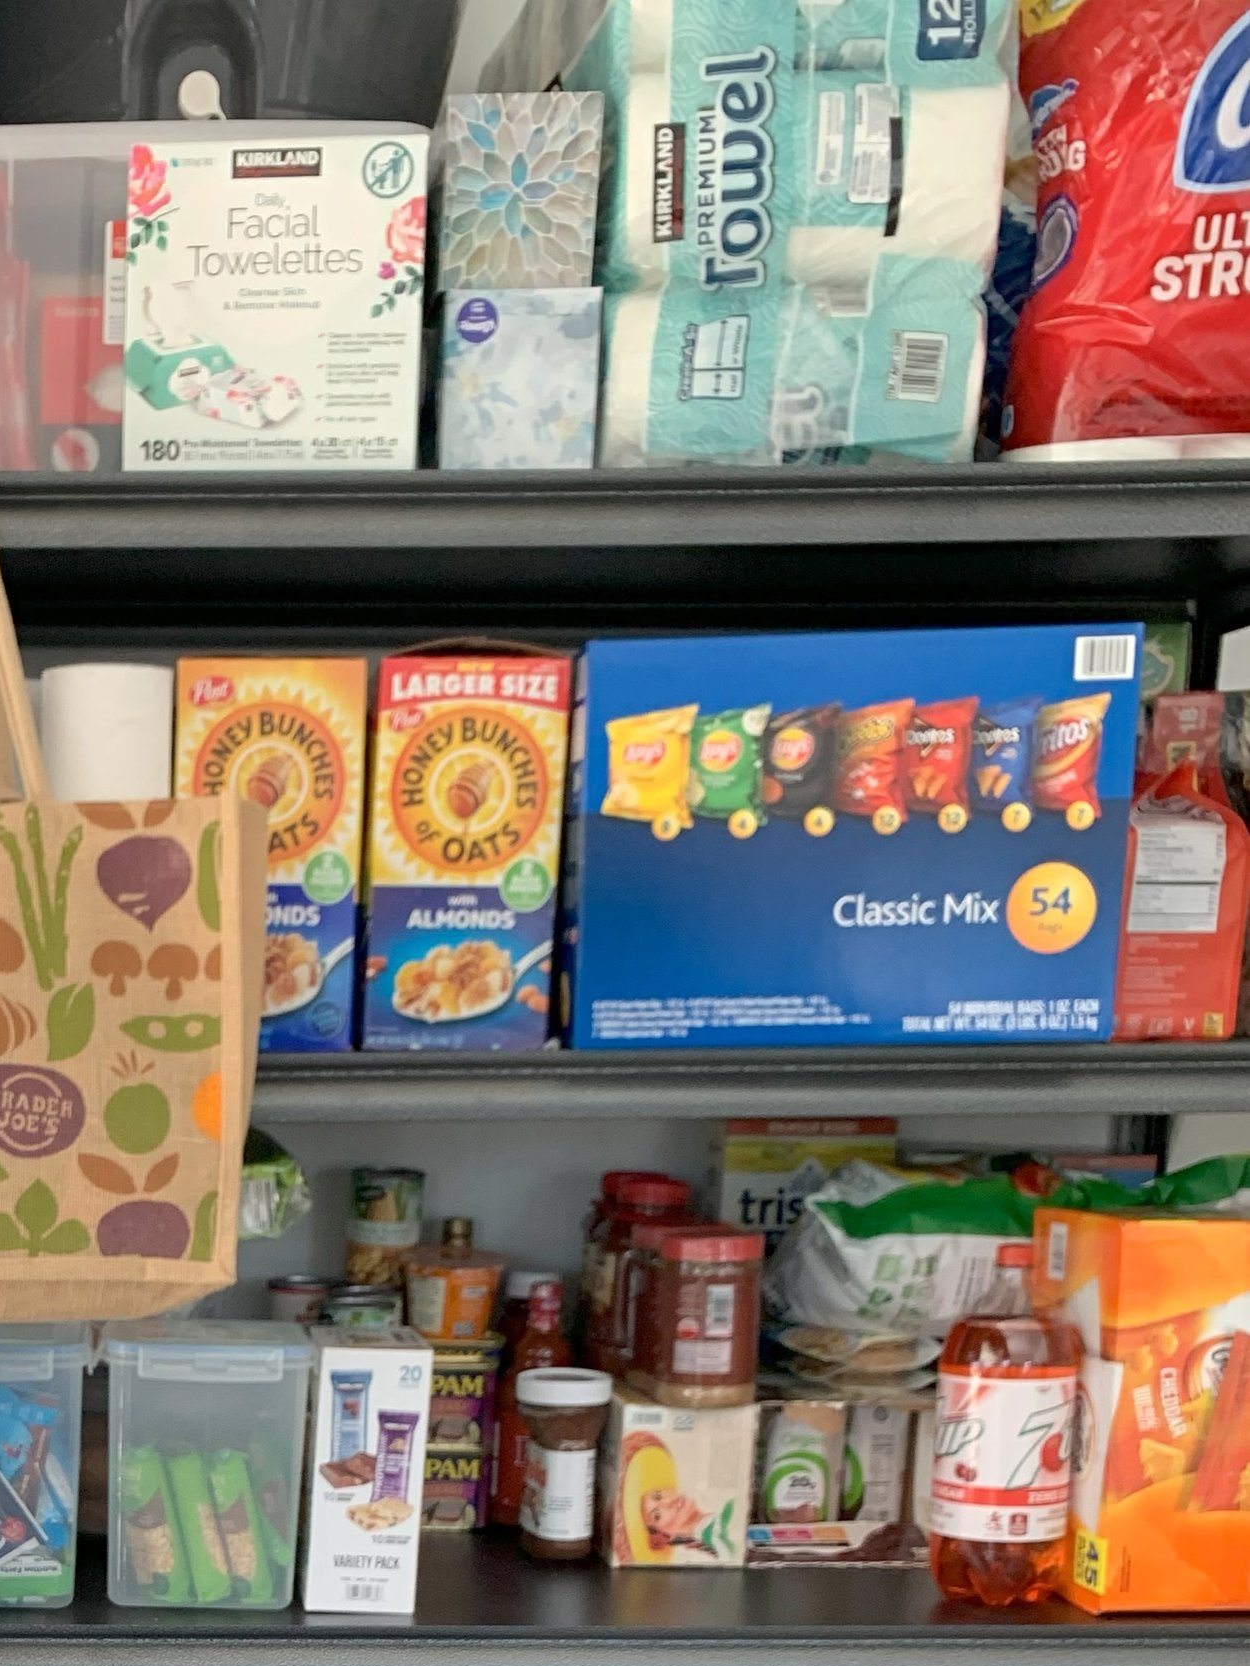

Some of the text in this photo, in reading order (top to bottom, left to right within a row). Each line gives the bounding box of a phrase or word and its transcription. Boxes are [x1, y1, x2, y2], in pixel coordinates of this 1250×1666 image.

[235, 150, 320, 168] KIRKLAND
[705, 50, 769, 286] Towel
[656, 126, 675, 238] KIRKLAND
[697, 105, 716, 245] PREMIUM
[255, 192, 287, 209] Daily
[227, 205, 322, 240] Facial
[186, 243, 365, 278] Towelettes
[1150, 251, 1250, 302] STR
[283, 286, 307, 297] Skin
[139, 440, 181, 461] 180
[193, 678, 230, 704] Post
[391, 673, 560, 701] LARGER SIZE
[390, 710, 422, 729] Post
[906, 727, 956, 745] Doritos
[974, 726, 1021, 744] Doritos
[204, 711, 335, 800] HONEY BUNCHES
[403, 716, 538, 809] HONEY BUNCHES
[268, 812, 320, 854] ATS
[416, 820, 521, 865] of OATS
[447, 894, 478, 907] with
[833, 890, 1000, 928] Classic Mix
[1028, 886, 1072, 917] 54
[266, 905, 321, 927] ONDS
[407, 908, 517, 931] ALMONDS
[902, 1016, 930, 1032] TOTAL
[739, 1187, 801, 1226] tris
[400, 1365, 423, 1382] 20
[433, 1374, 485, 1398] PAM
[1160, 1367, 1188, 1438] CHEDDAR
[375, 1455, 389, 1494] PROTEIN
[424, 1457, 482, 1480] PAM
[372, 1535, 384, 1545] 10
[0, 1564, 21, 1575] Facts
[333, 1553, 400, 1570] VARIETY PACK
[1084, 1540, 1098, 1587] 45
